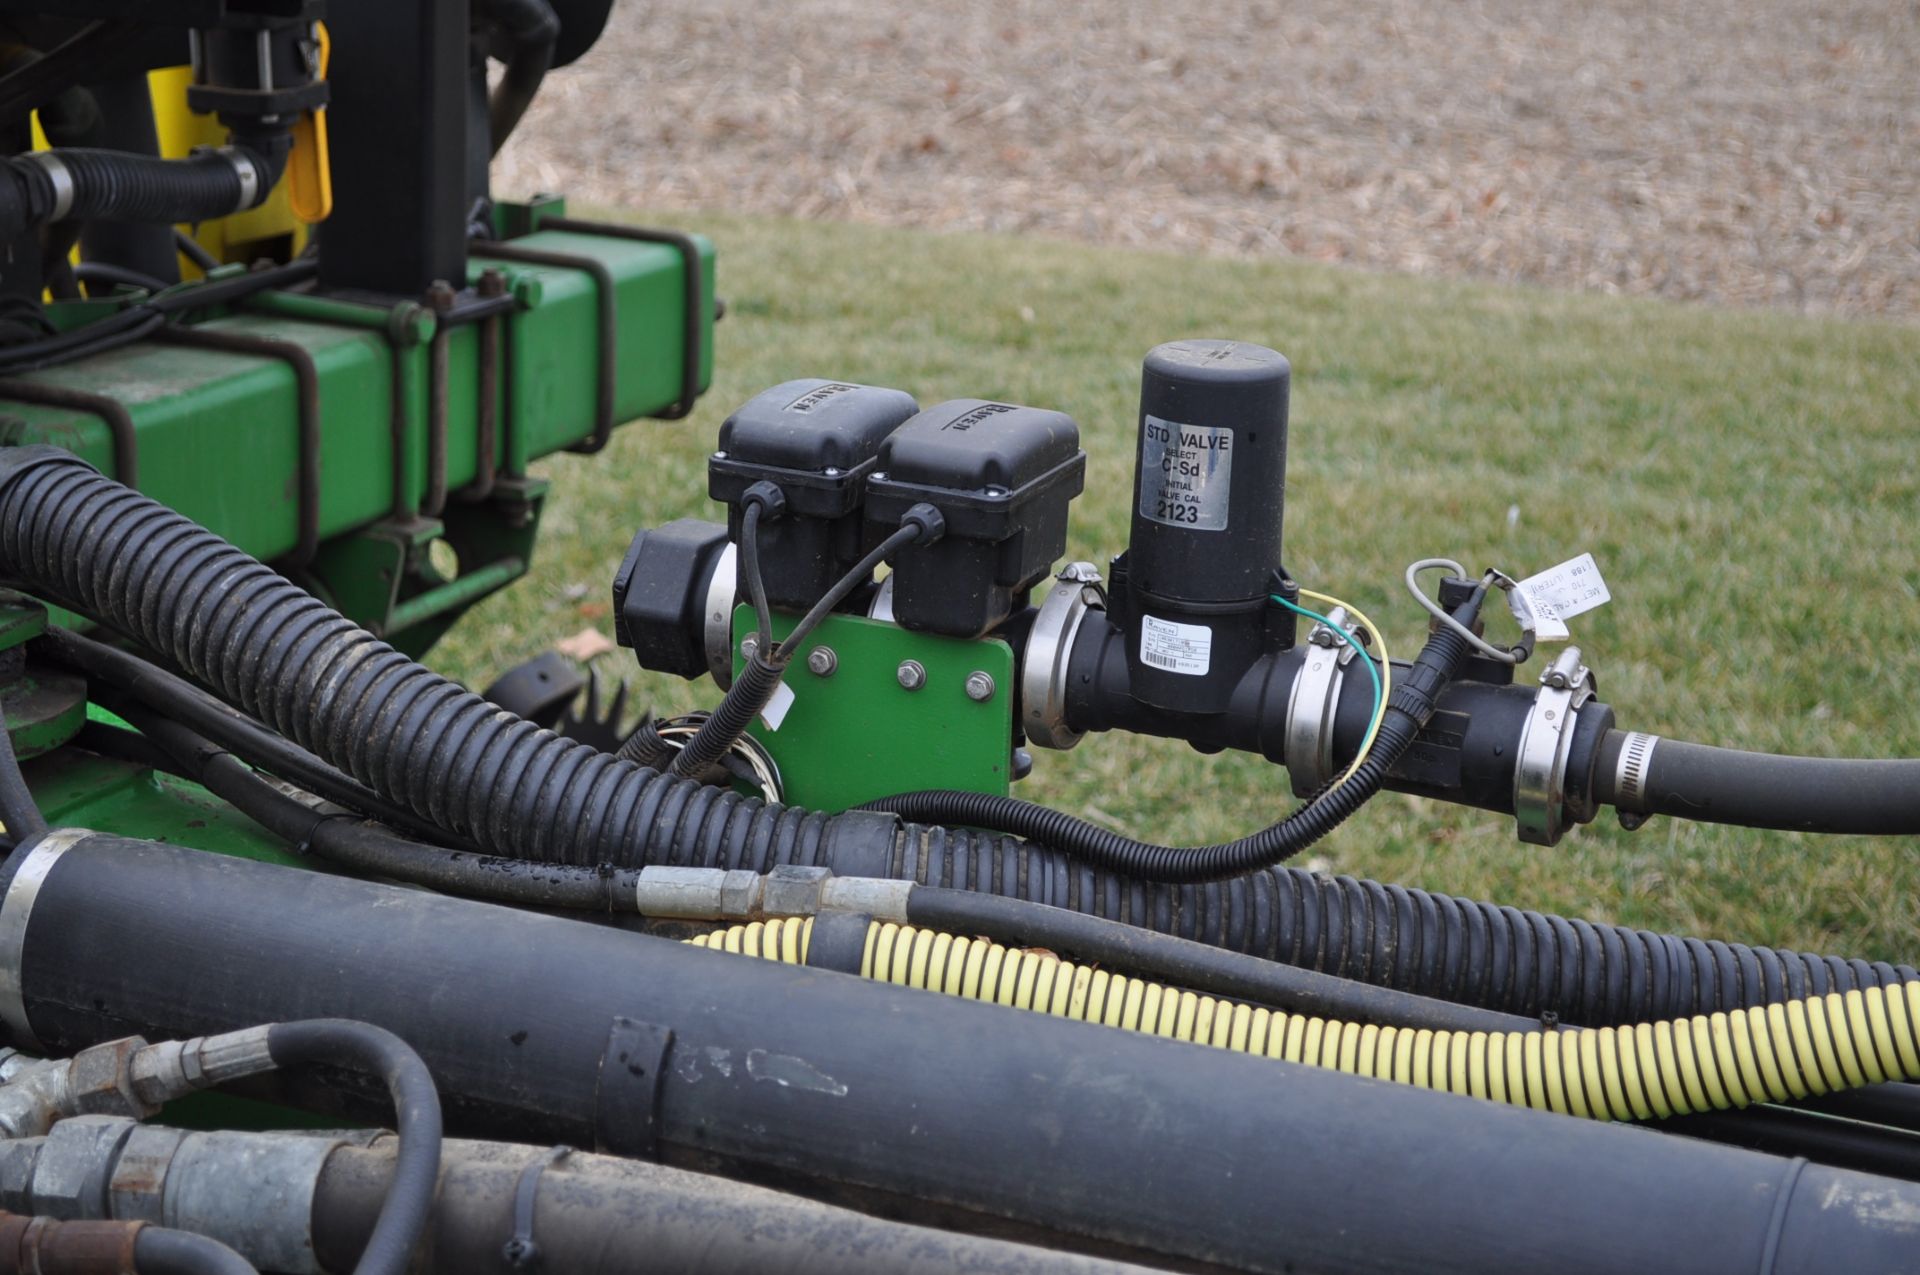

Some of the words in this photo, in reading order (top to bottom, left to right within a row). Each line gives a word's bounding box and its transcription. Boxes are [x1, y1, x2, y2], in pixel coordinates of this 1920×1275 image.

[793, 386, 849, 411] RAVEN
[952, 405, 1009, 431] RAVEN
[1147, 424, 1170, 443] STD
[1180, 432, 1229, 450] VALVE
[1166, 447, 1198, 460] SELECT
[1162, 458, 1200, 477] C-Sd
[1165, 479, 1193, 491] INITIAL
[1184, 494, 1201, 504] CAL
[1157, 500, 1198, 524] 2123
